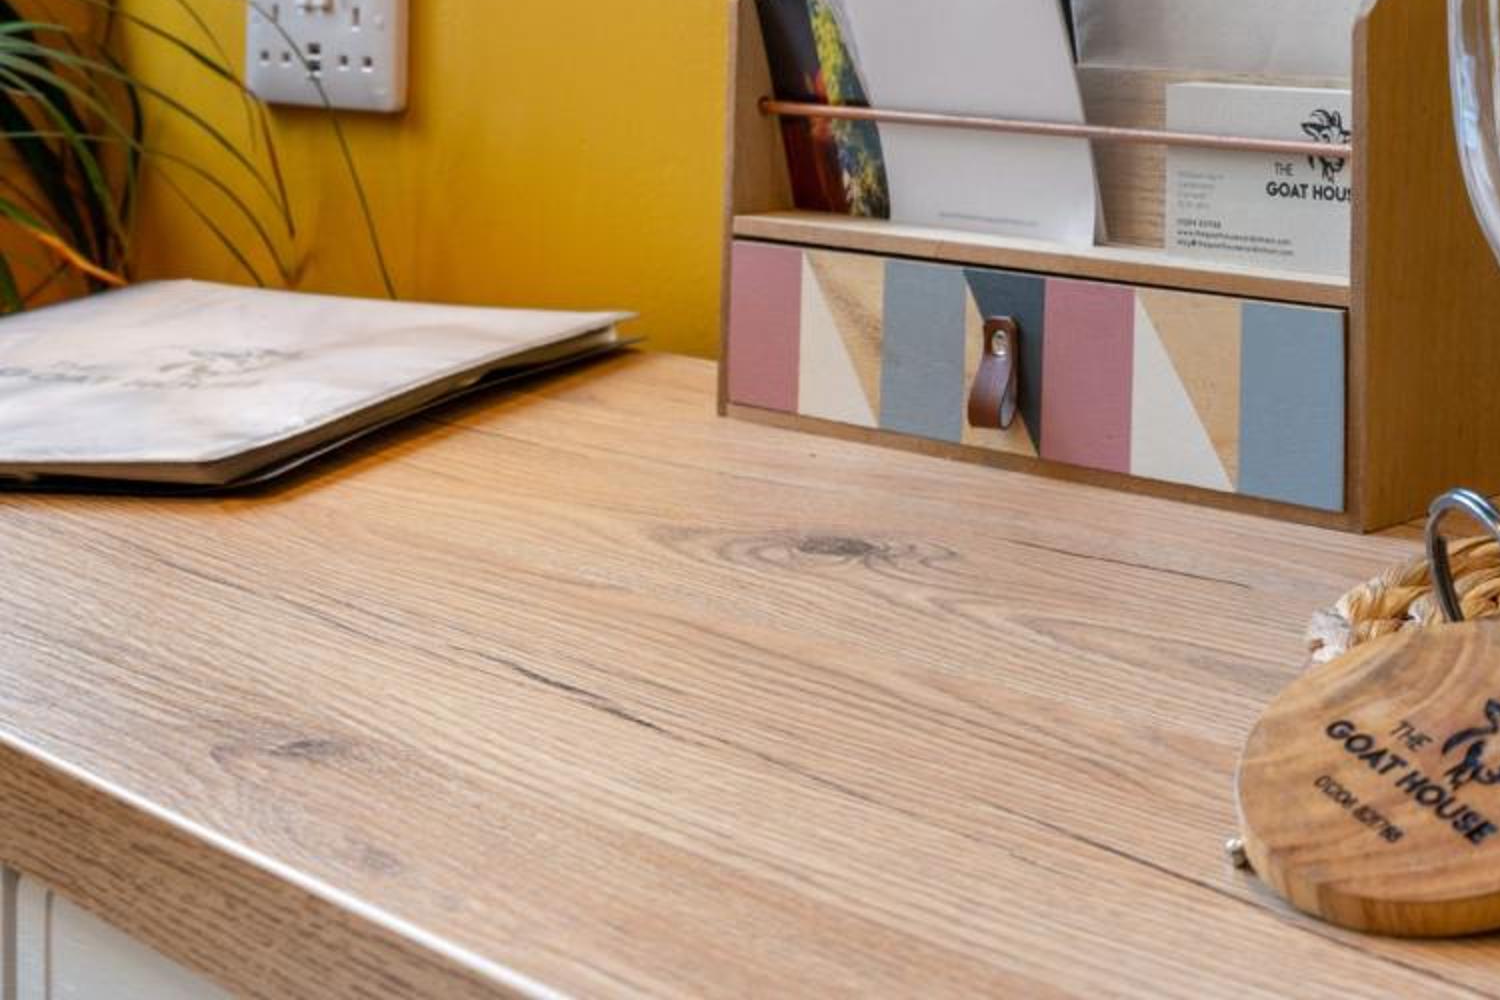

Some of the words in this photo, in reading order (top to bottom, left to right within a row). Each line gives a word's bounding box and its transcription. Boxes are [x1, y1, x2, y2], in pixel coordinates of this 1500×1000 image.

[1275, 162, 1295, 177] THE
[1266, 181, 1309, 199] GOAT
[1312, 184, 1351, 202] HOU
[1390, 720, 1433, 752] THE
[1326, 720, 1408, 775] GOAT
[1394, 770, 1498, 845] HOUSE
